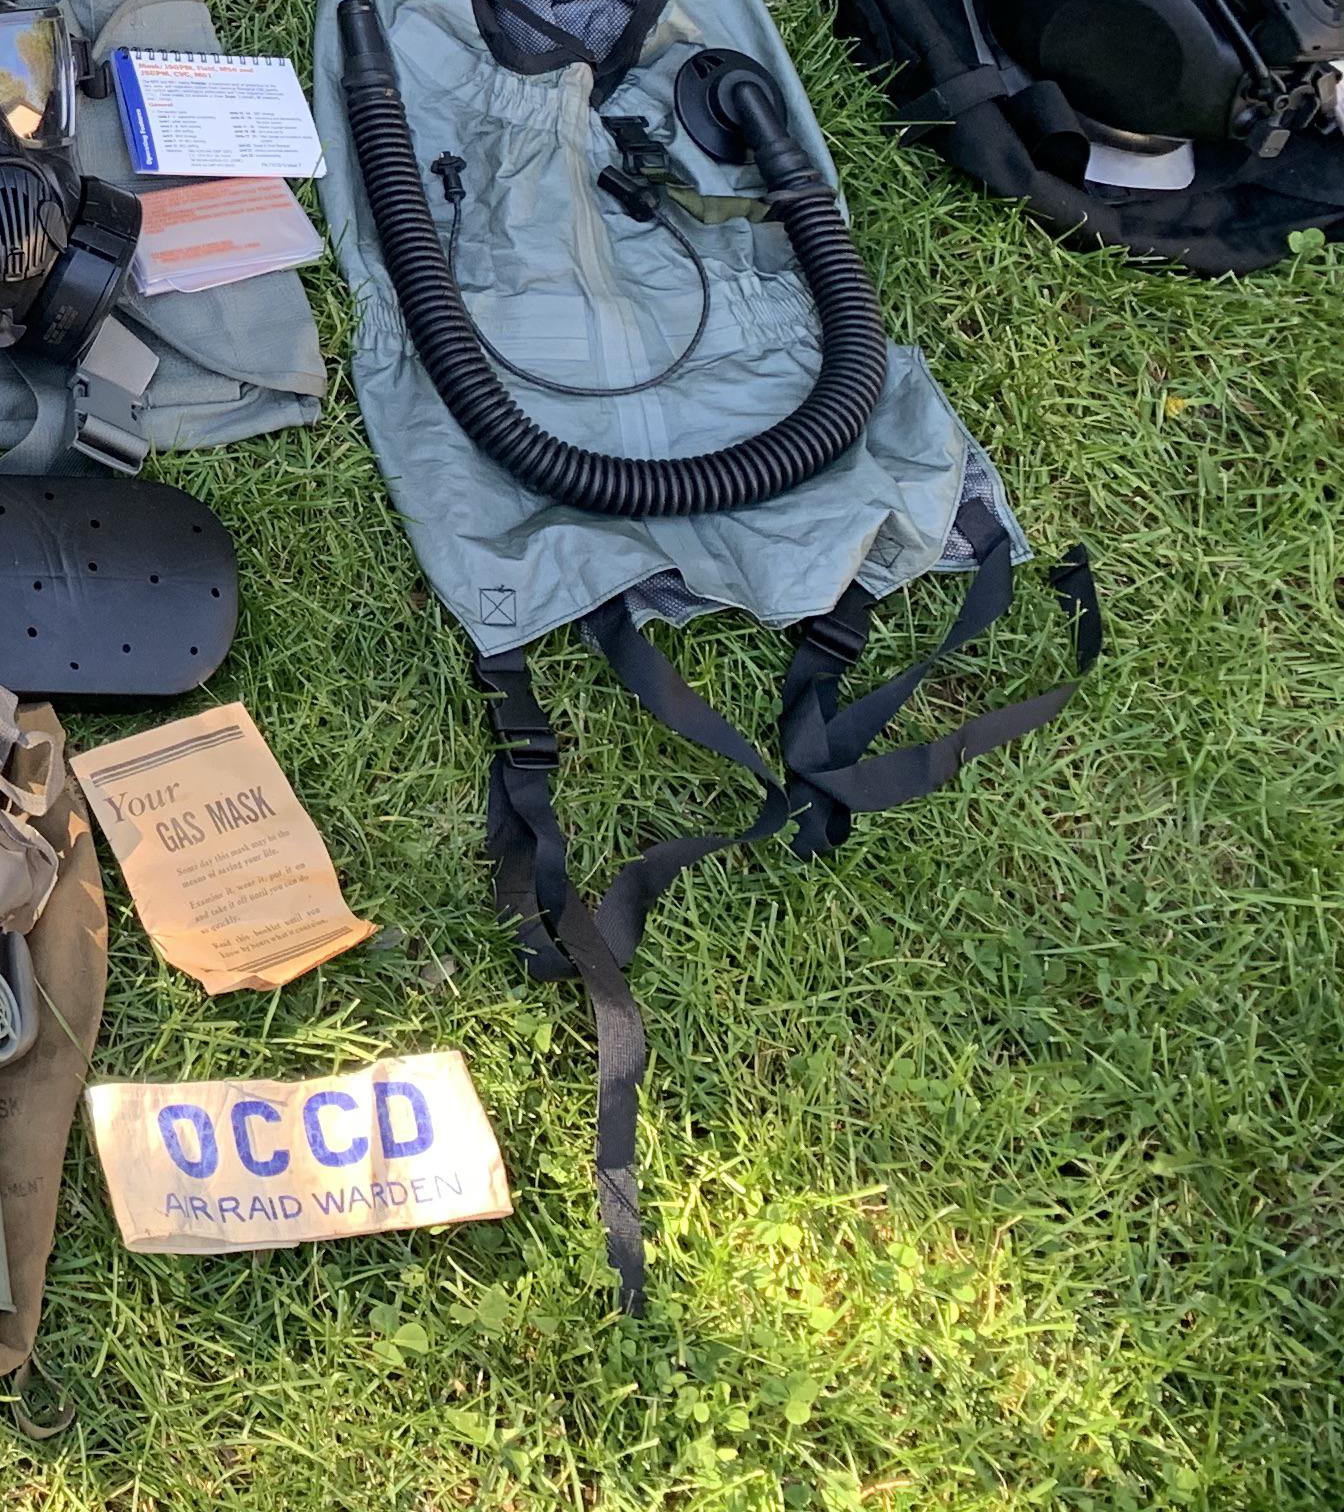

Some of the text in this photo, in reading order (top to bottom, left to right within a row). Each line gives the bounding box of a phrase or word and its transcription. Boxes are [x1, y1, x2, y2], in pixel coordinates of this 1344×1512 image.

[102, 781, 180, 823] Your
[155, 785, 277, 854] GAS MASK
[199, 858, 213, 871] day
[214, 853, 229, 865] this
[229, 846, 250, 860] mask
[250, 840, 267, 852] may
[217, 863, 243, 879] saving
[263, 848, 279, 861] life.
[158, 1081, 434, 1179] OCCD
[311, 1172, 463, 1216] WARDEN
